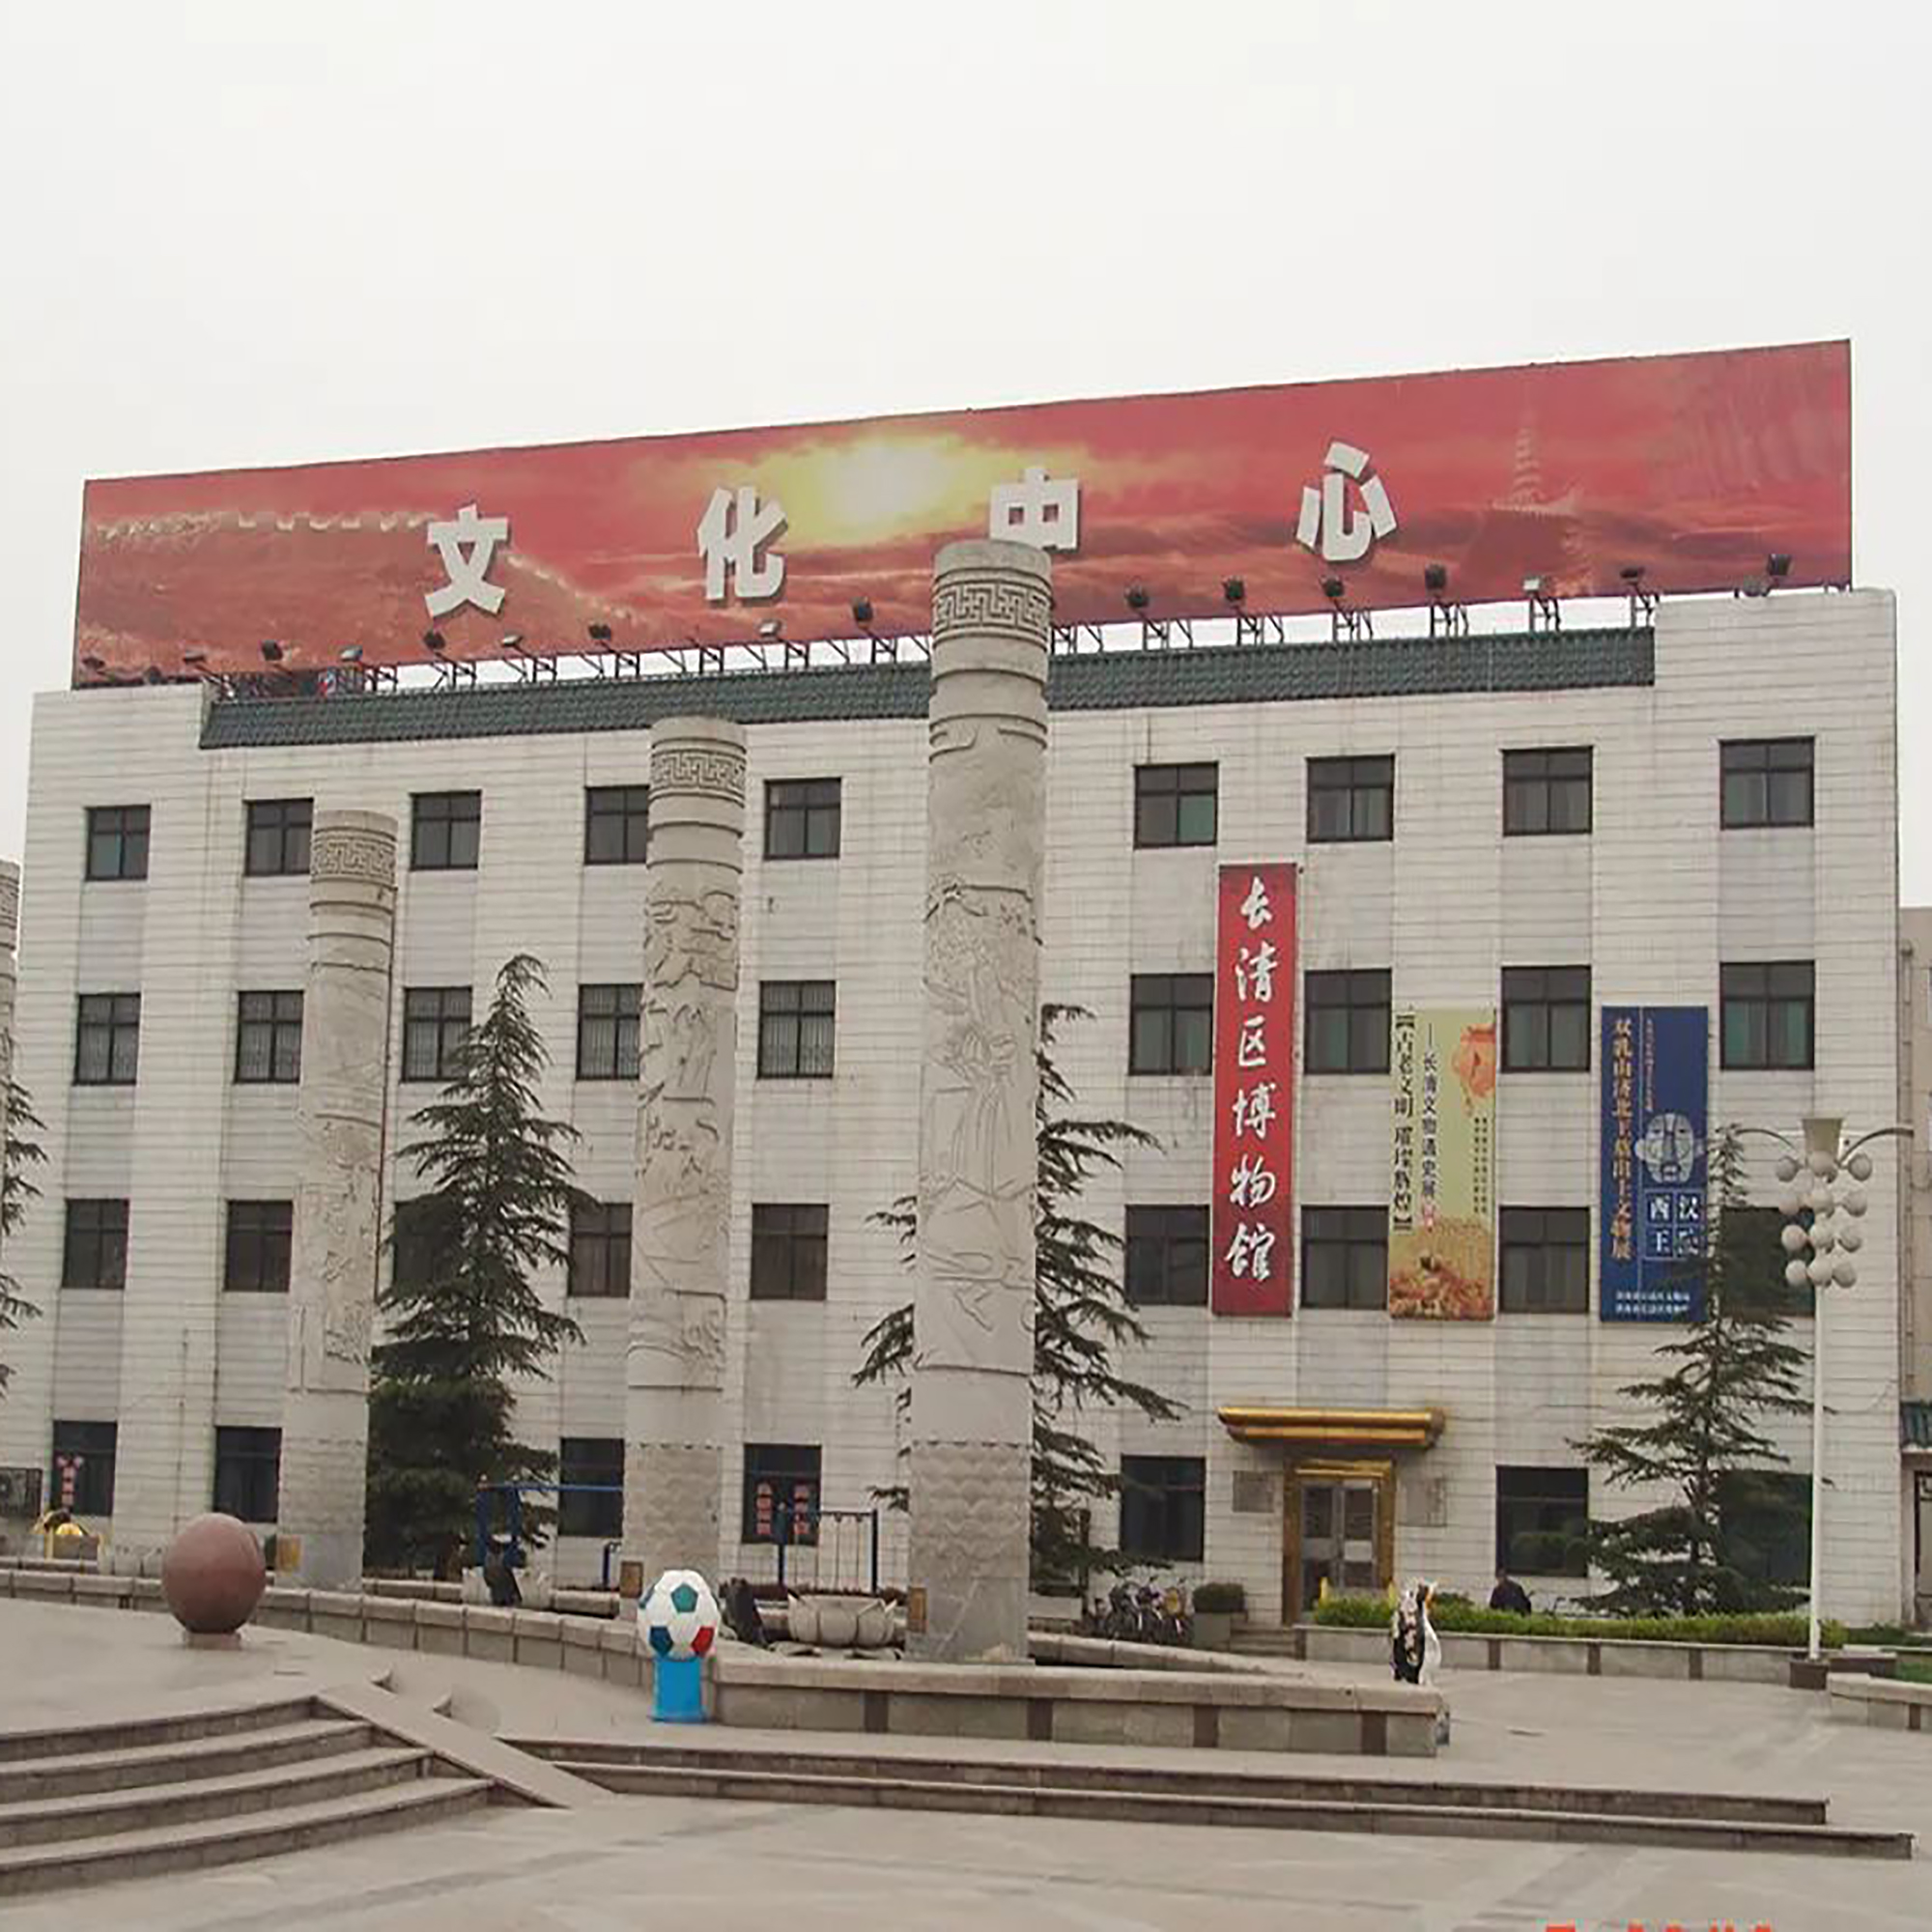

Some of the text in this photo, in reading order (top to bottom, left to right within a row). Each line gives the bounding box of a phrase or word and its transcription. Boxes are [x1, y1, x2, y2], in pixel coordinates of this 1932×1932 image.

[425, 441, 1396, 616] 文化中心
[1224, 875, 1278, 1281] 长清区博物馆
